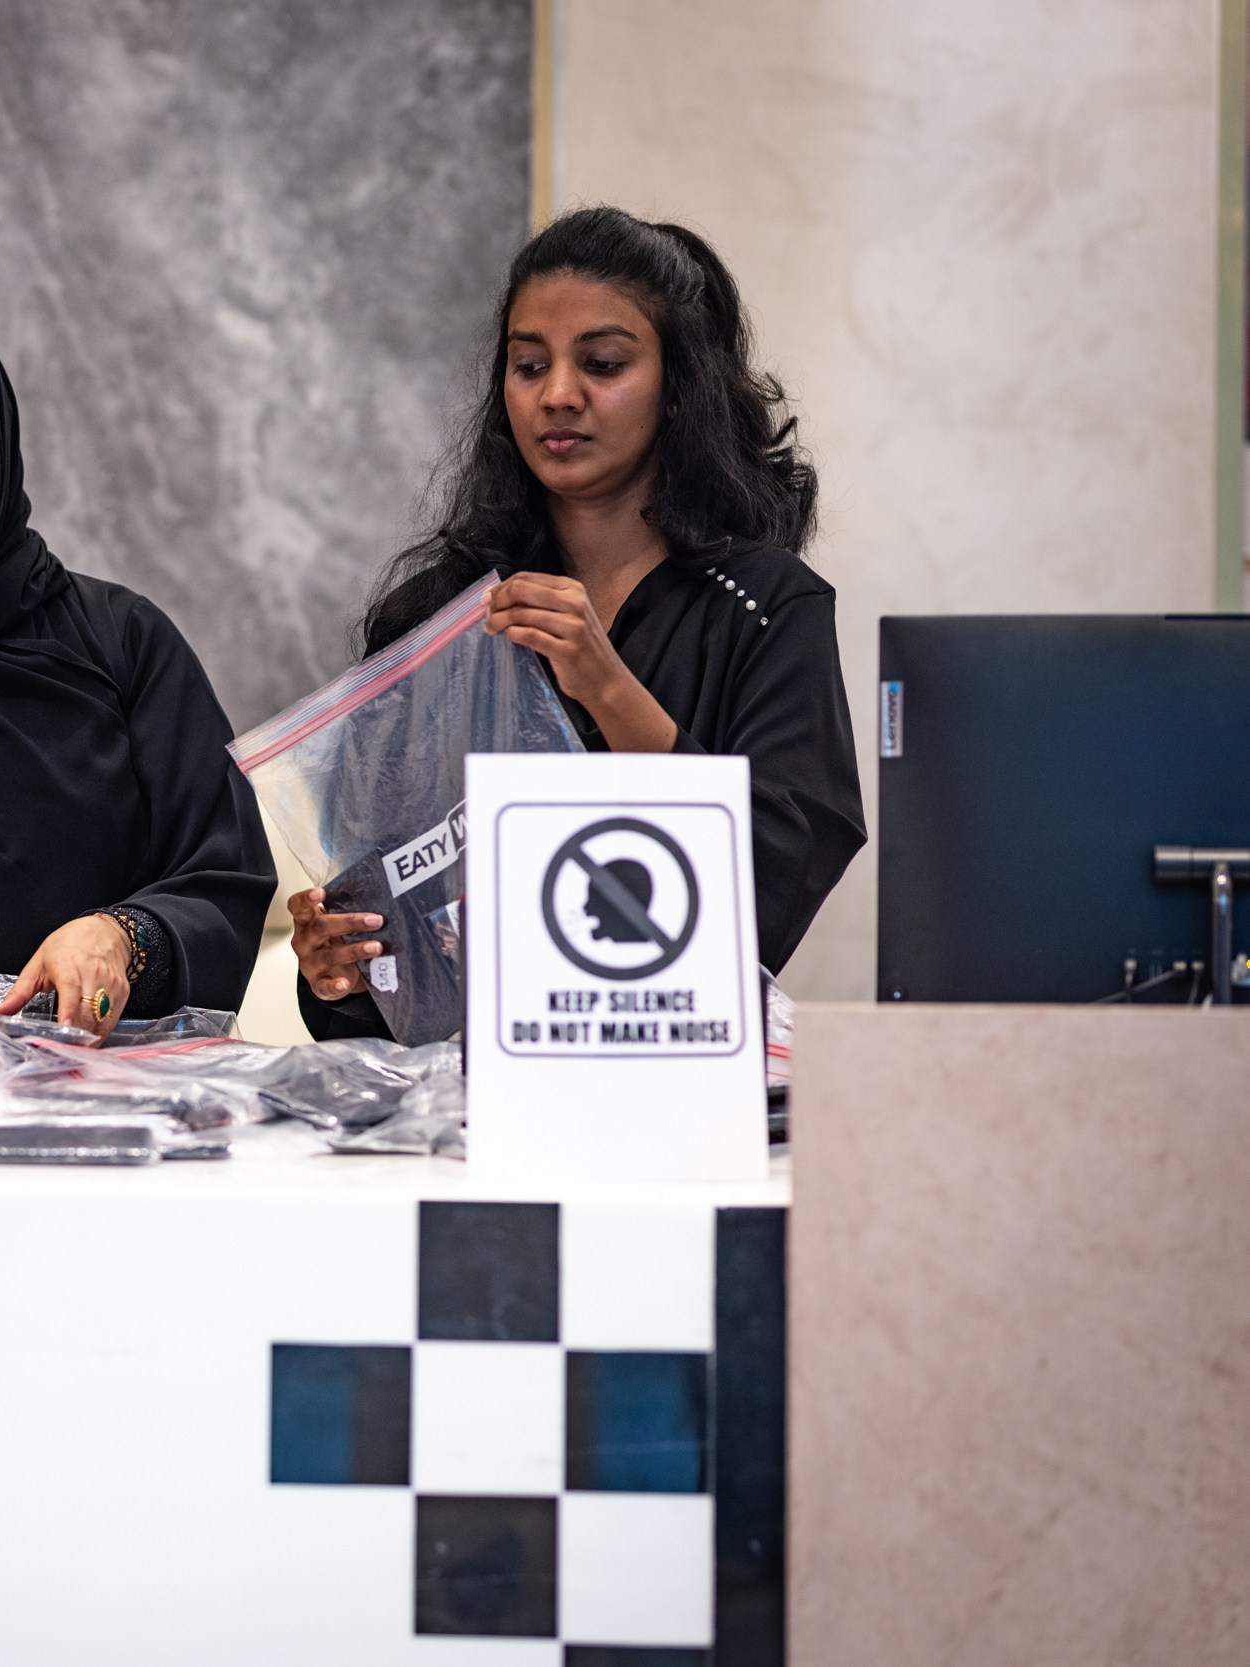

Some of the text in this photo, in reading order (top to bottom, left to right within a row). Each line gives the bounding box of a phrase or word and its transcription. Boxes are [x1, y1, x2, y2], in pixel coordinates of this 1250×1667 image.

[393, 832, 448, 882] EATY
[548, 989, 695, 1013] KEEP SILENCE
[512, 1020, 729, 1043] DO NOT MAKE NOISE
